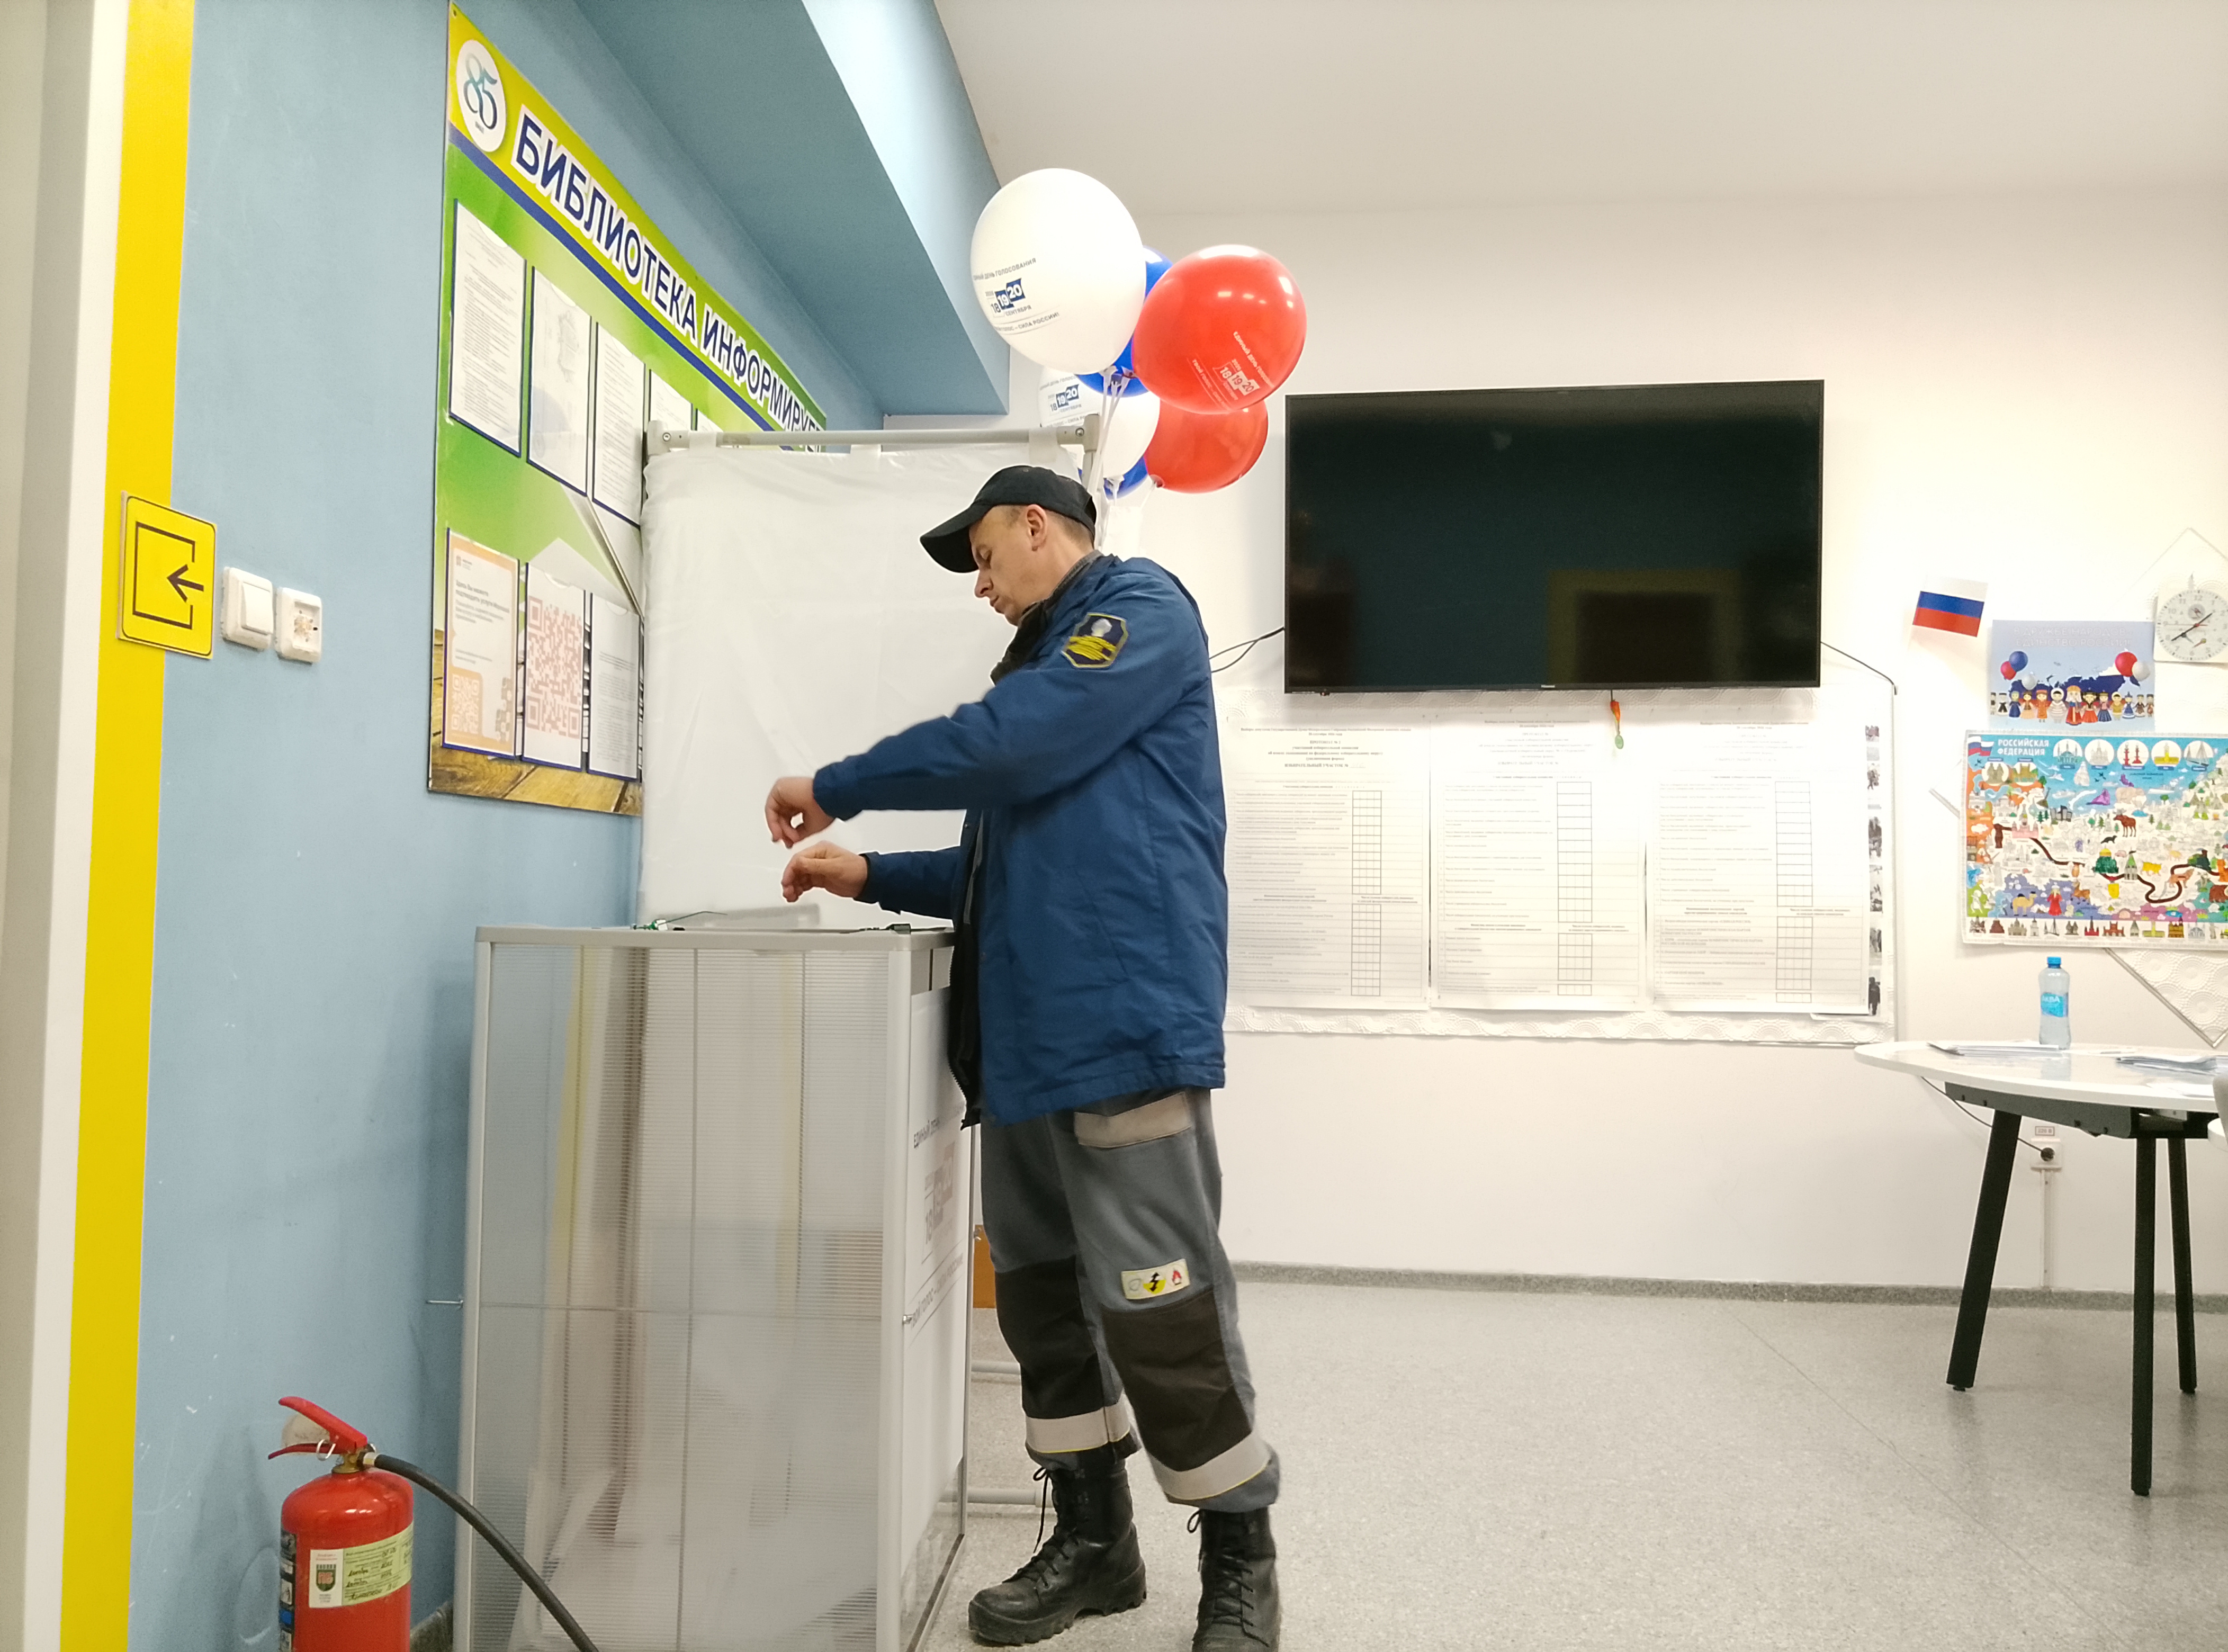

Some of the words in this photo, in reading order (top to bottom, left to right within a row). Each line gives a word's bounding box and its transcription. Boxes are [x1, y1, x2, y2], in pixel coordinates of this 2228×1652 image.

[463, 53, 497, 130] 85
[518, 113, 697, 342] БИБЛИОТЕКА
[995, 258, 1036, 277] ГОЛОСОВАНИЯ
[991, 303, 1001, 313] 18
[998, 294, 1010, 307] 19
[1007, 284, 1022, 299] 20
[1005, 305, 1032, 316] СЕНТЯБРЯ
[1032, 312, 1060, 325] РОССИИ!
[1233, 331, 1250, 355] ЕДИНЫЙ
[1220, 367, 1233, 379] 18
[1232, 375, 1243, 385] 19
[1242, 381, 1254, 392] 20
[1050, 403, 1057, 412] 18
[1057, 394, 1066, 406] 19
[1066, 388, 1078, 399] 20
[2023, 627, 2068, 636] ДРУЖБЕ
[2072, 627, 2126, 637] НАРОДОВ
[2017, 638, 2077, 647] ЕДИНСТВО
[2081, 639, 2131, 647] РОССИИ!
[1997, 747, 2045, 756] ФЕДЕРАЦИЯ
[1998, 738, 2050, 747] РОССИЙСКАЯ
